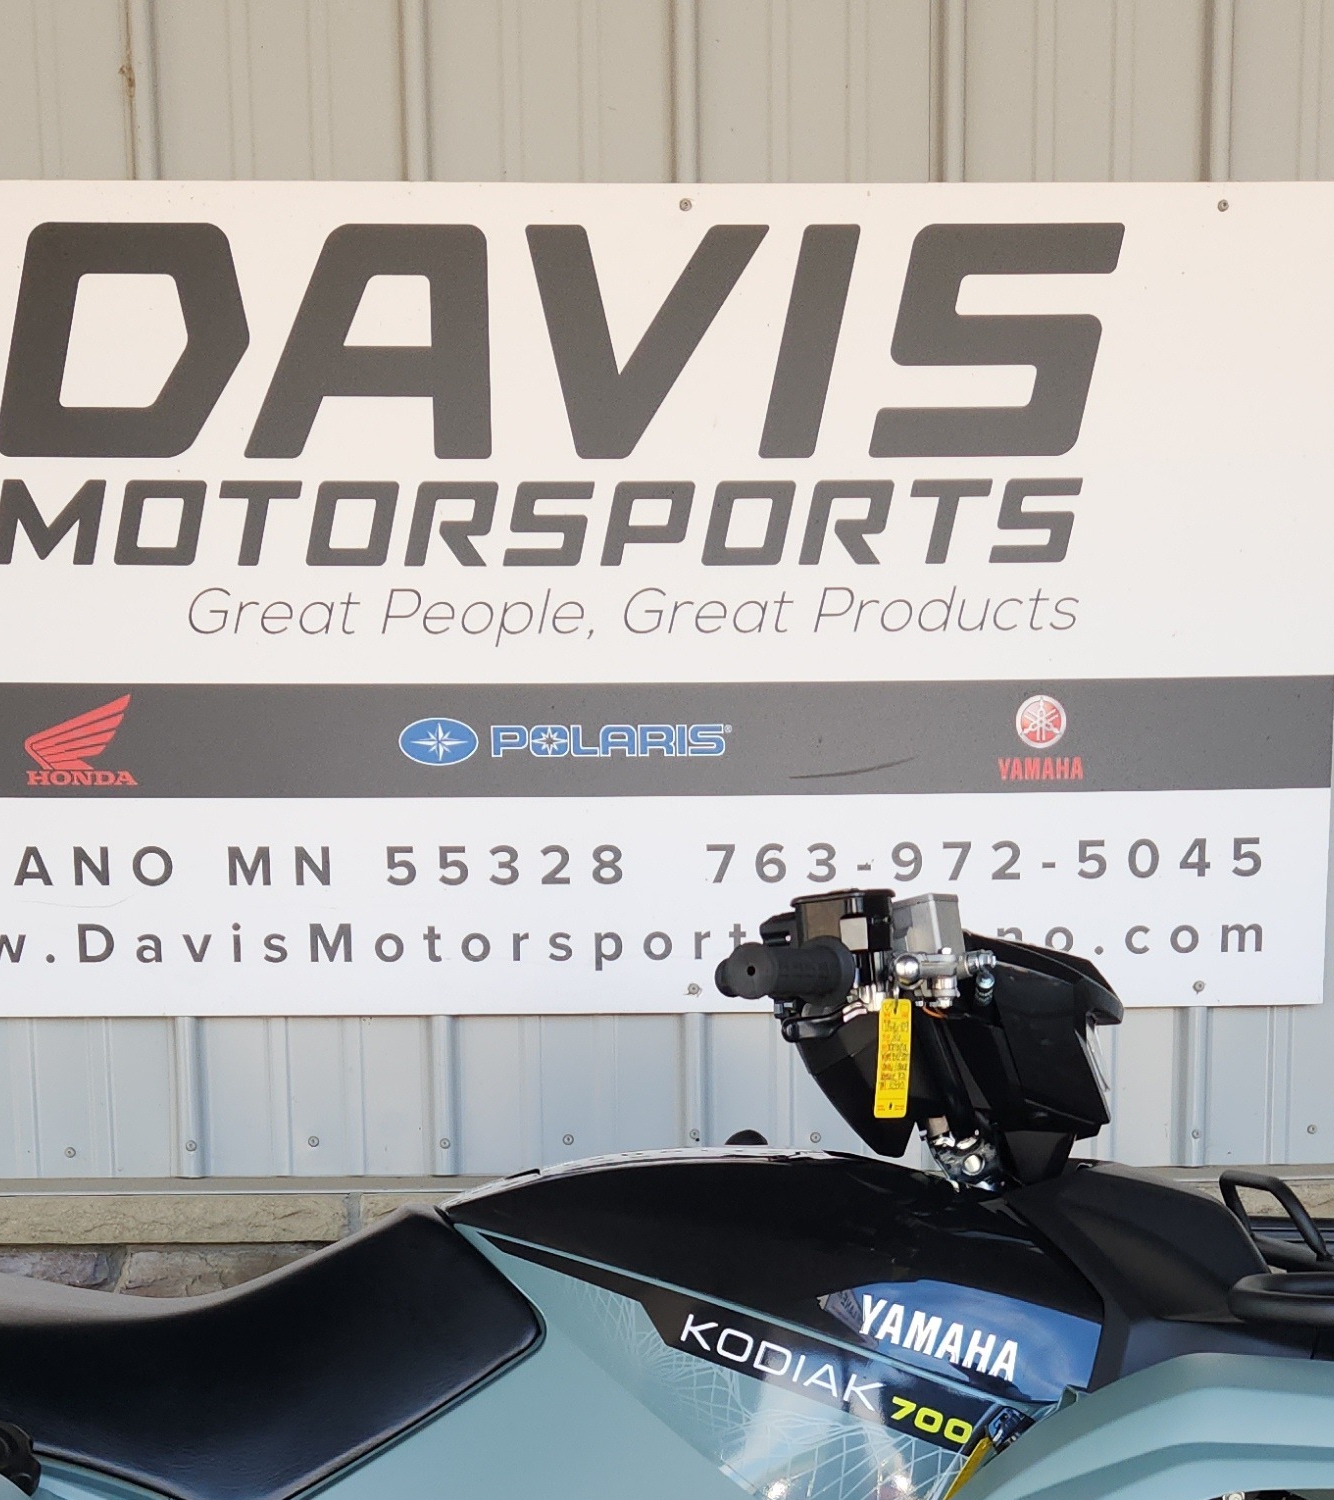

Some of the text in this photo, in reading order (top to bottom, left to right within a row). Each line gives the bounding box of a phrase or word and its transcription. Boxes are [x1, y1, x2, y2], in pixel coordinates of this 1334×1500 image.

[188, 585, 1080, 648] Great People, Great Products
[490, 724, 726, 757] POLARIS
[26, 770, 138, 786] HONDA
[997, 756, 1083, 781] YAMAHA
[227, 846, 332, 886] MN
[385, 844, 624, 886] 55328
[705, 836, 1264, 885] 763-972-5045
[858, 1293, 1019, 1383] YAMAHA
[680, 1313, 972, 1444] KODIAK 700
